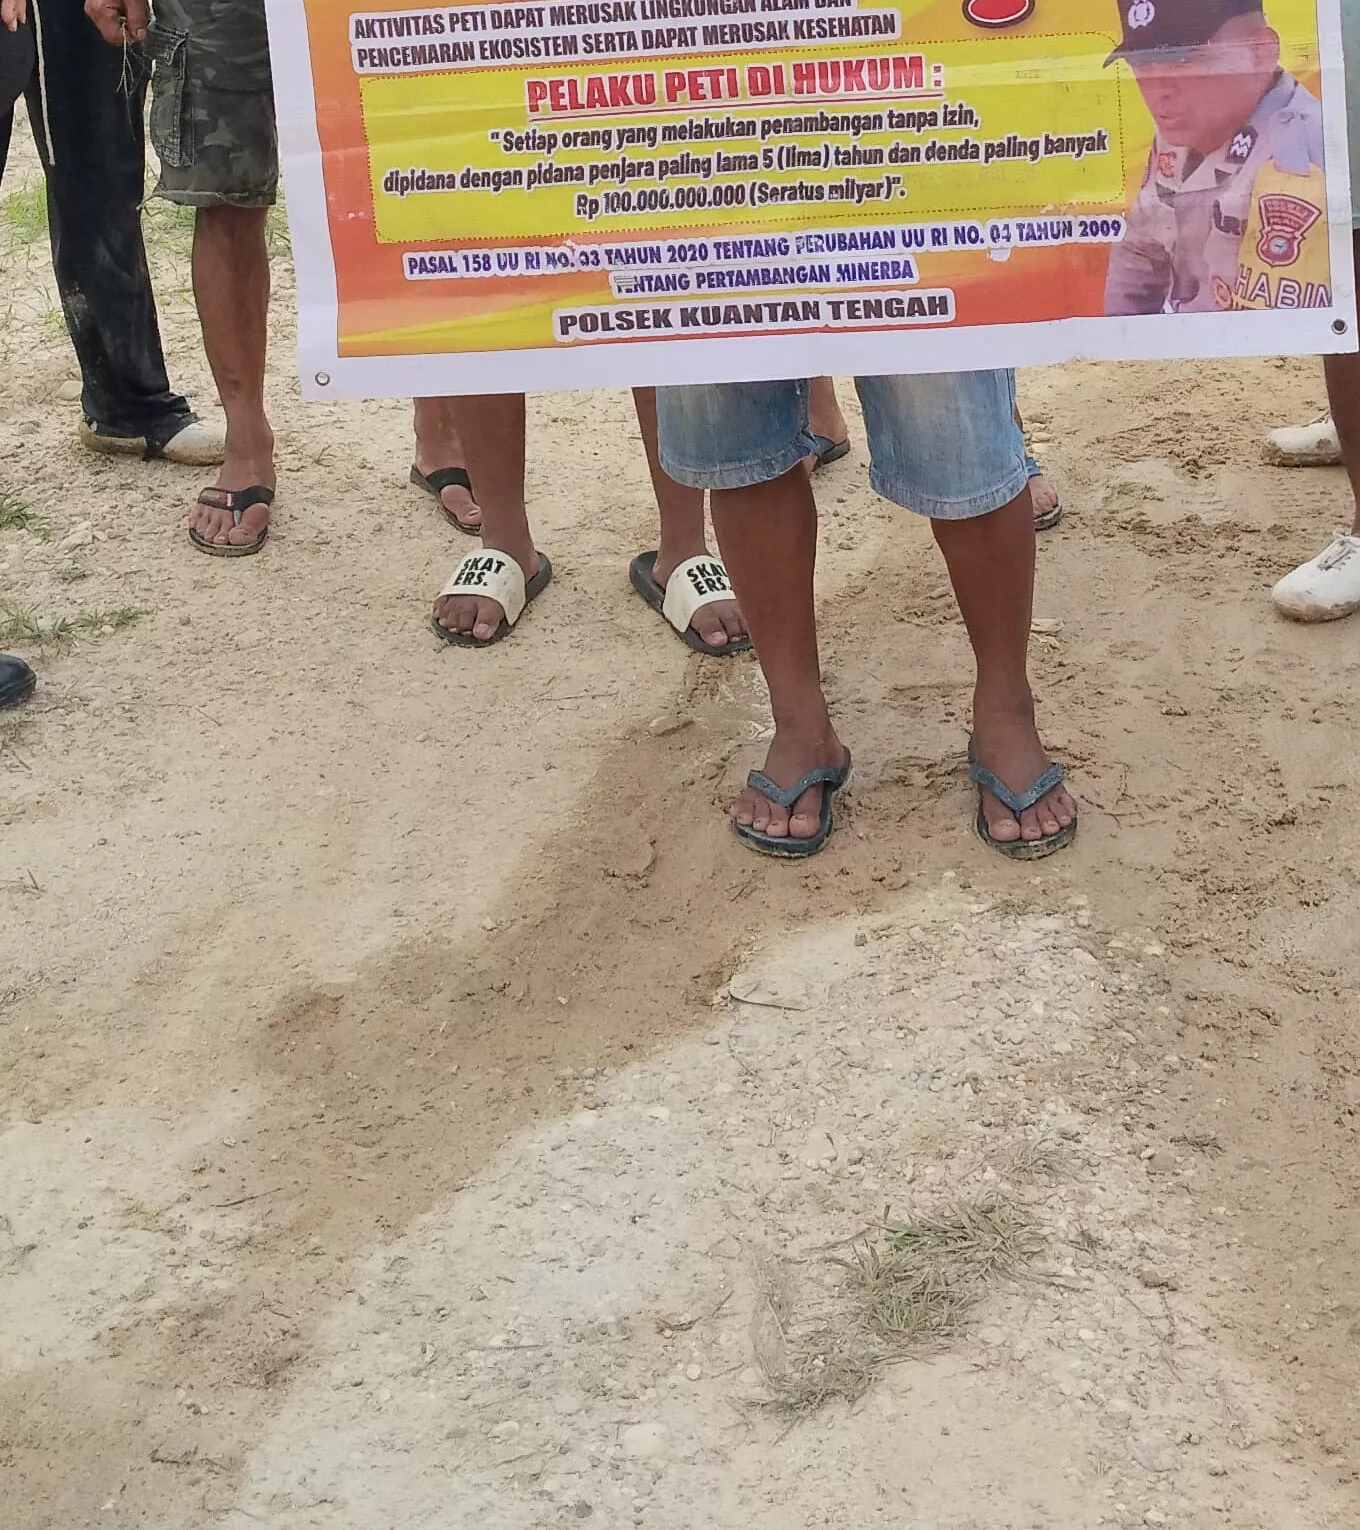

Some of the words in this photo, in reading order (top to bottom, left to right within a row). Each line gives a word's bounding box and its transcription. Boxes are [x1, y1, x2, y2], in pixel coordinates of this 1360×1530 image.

[354, 14, 445, 39] AKTIVITAS
[449, 11, 487, 33] PETI
[491, 7, 546, 30] DAPAT
[550, 1, 638, 26] MERUSAK
[357, 42, 476, 68] PENCEMARAN
[479, 35, 579, 61] EKOSISTEM
[582, 30, 638, 54] SERTA
[642, 28, 698, 51] DAPAT
[702, 21, 789, 46] MERUSAK
[793, 13, 896, 40] KESEHATAN
[527, 73, 656, 113] PELAKU
[665, 68, 738, 103] PETI
[747, 64, 785, 97] DI
[793, 55, 924, 97] HUKUM
[562, 129, 612, 151] orang
[616, 125, 657, 149] yang
[662, 117, 757, 143] melakukan
[761, 112, 883, 141] penambangan
[887, 108, 938, 133] tanpa
[942, 103, 979, 128] izin,
[383, 168, 456, 196] dipidana
[460, 167, 522, 193] dengan
[527, 163, 585, 190] pidana
[589, 157, 655, 186] penjara
[658, 153, 712, 181] paling
[716, 151, 758, 174] lama
[762, 147, 774, 168] 5
[777, 144, 830, 172] (lima)
[834, 142, 884, 167] tahun
[888, 141, 921, 165] dan
[925, 139, 980, 164] denda
[984, 135, 1040, 164] paling
[1043, 129, 1108, 159] banyak
[576, 193, 600, 220] Rp
[603, 184, 746, 214] 100.000.000.000
[749, 179, 825, 208] (Seratus
[407, 254, 457, 276] PASAL
[462, 252, 491, 272] 158
[497, 250, 519, 271] UU
[524, 249, 540, 270] RI
[545, 250, 575, 269] NO.
[605, 243, 662, 266] TAHUN
[667, 242, 709, 263] 2020
[713, 236, 790, 260] TENTANG
[795, 227, 897, 254] PERUBAHAN
[900, 228, 925, 248] UU
[931, 226, 947, 246] RI
[953, 225, 985, 245] NO.
[1016, 220, 1073, 242] TAHUN
[1077, 219, 1122, 239] 2009
[696, 263, 831, 290] PERTAMBANGAN
[836, 259, 915, 283] MINERBA
[558, 307, 672, 336] POLSEK
[679, 300, 821, 327] KUANTAN
[825, 294, 949, 320] TENGAH
[464, 556, 506, 575] SKAT
